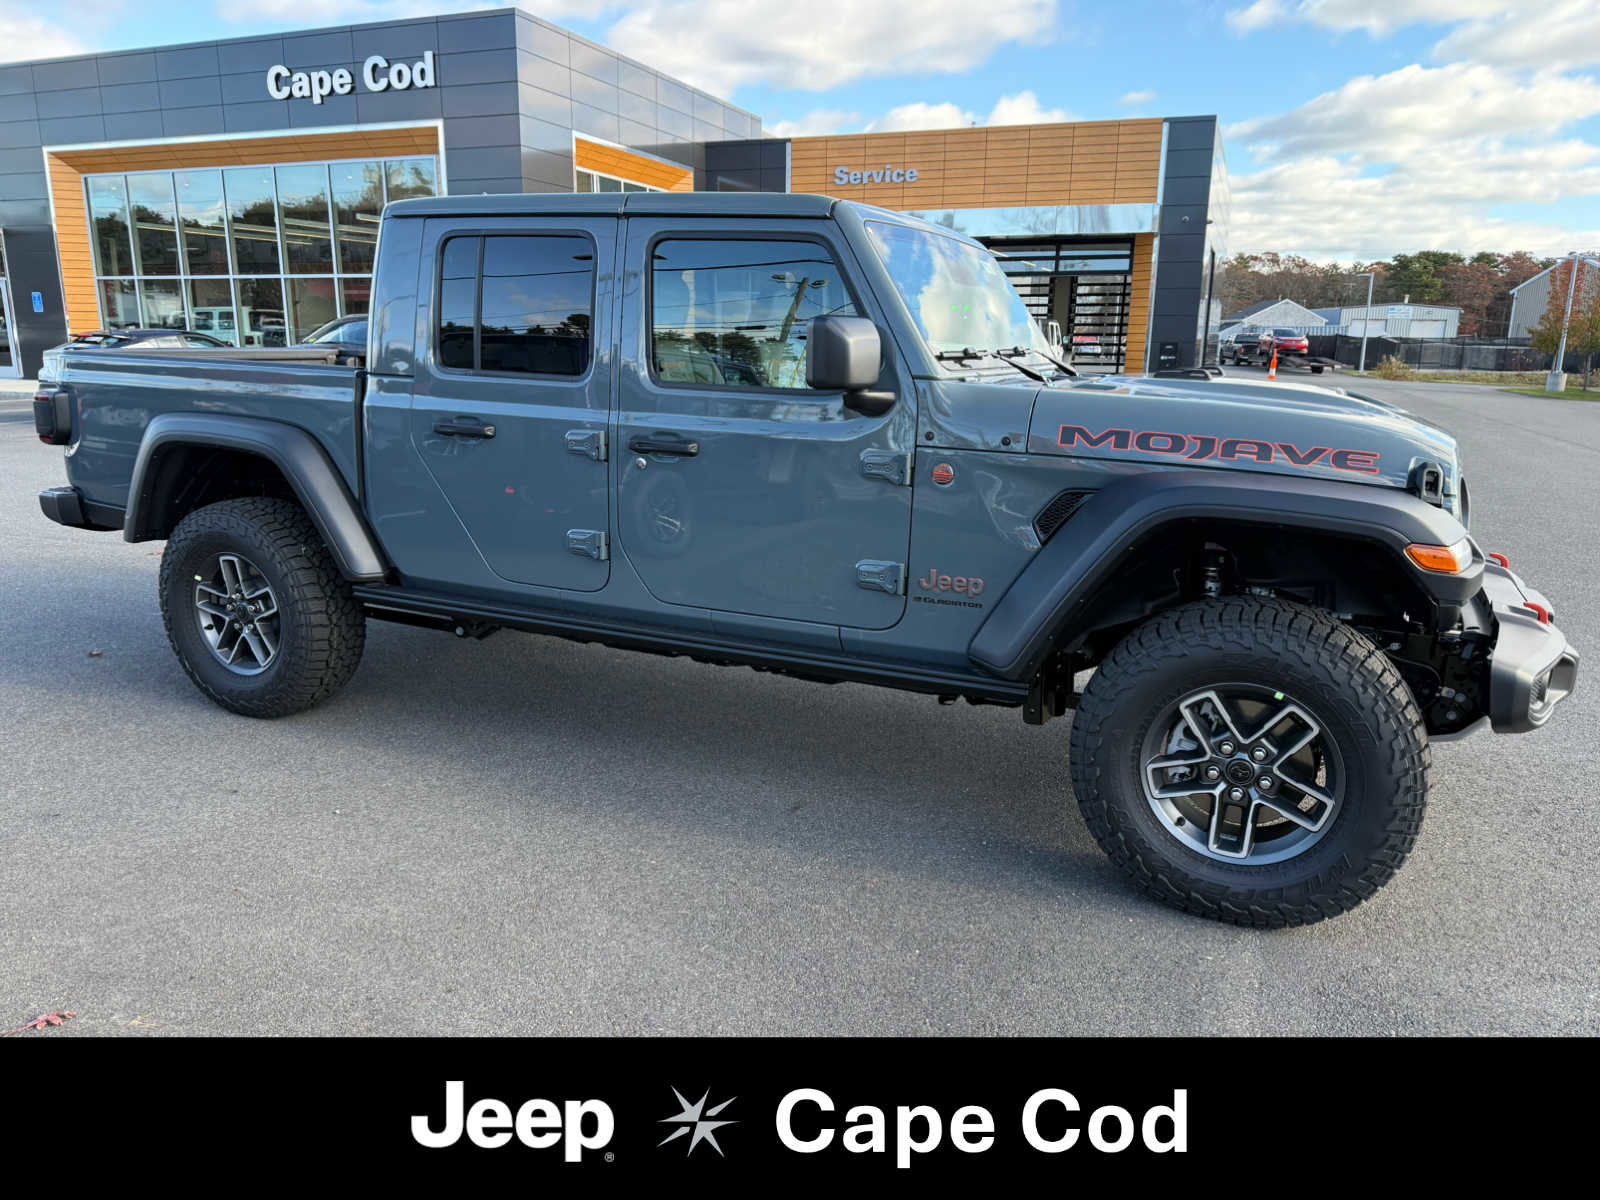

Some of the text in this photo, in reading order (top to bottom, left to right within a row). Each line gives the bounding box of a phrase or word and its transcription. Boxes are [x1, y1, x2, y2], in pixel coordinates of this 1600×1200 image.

[266, 50, 436, 105] Cape Cod
[834, 164, 919, 186] Service
[1057, 424, 1381, 474] MOJAVE
[919, 568, 985, 600] Jeep
[923, 597, 983, 609] GLADIATOR
